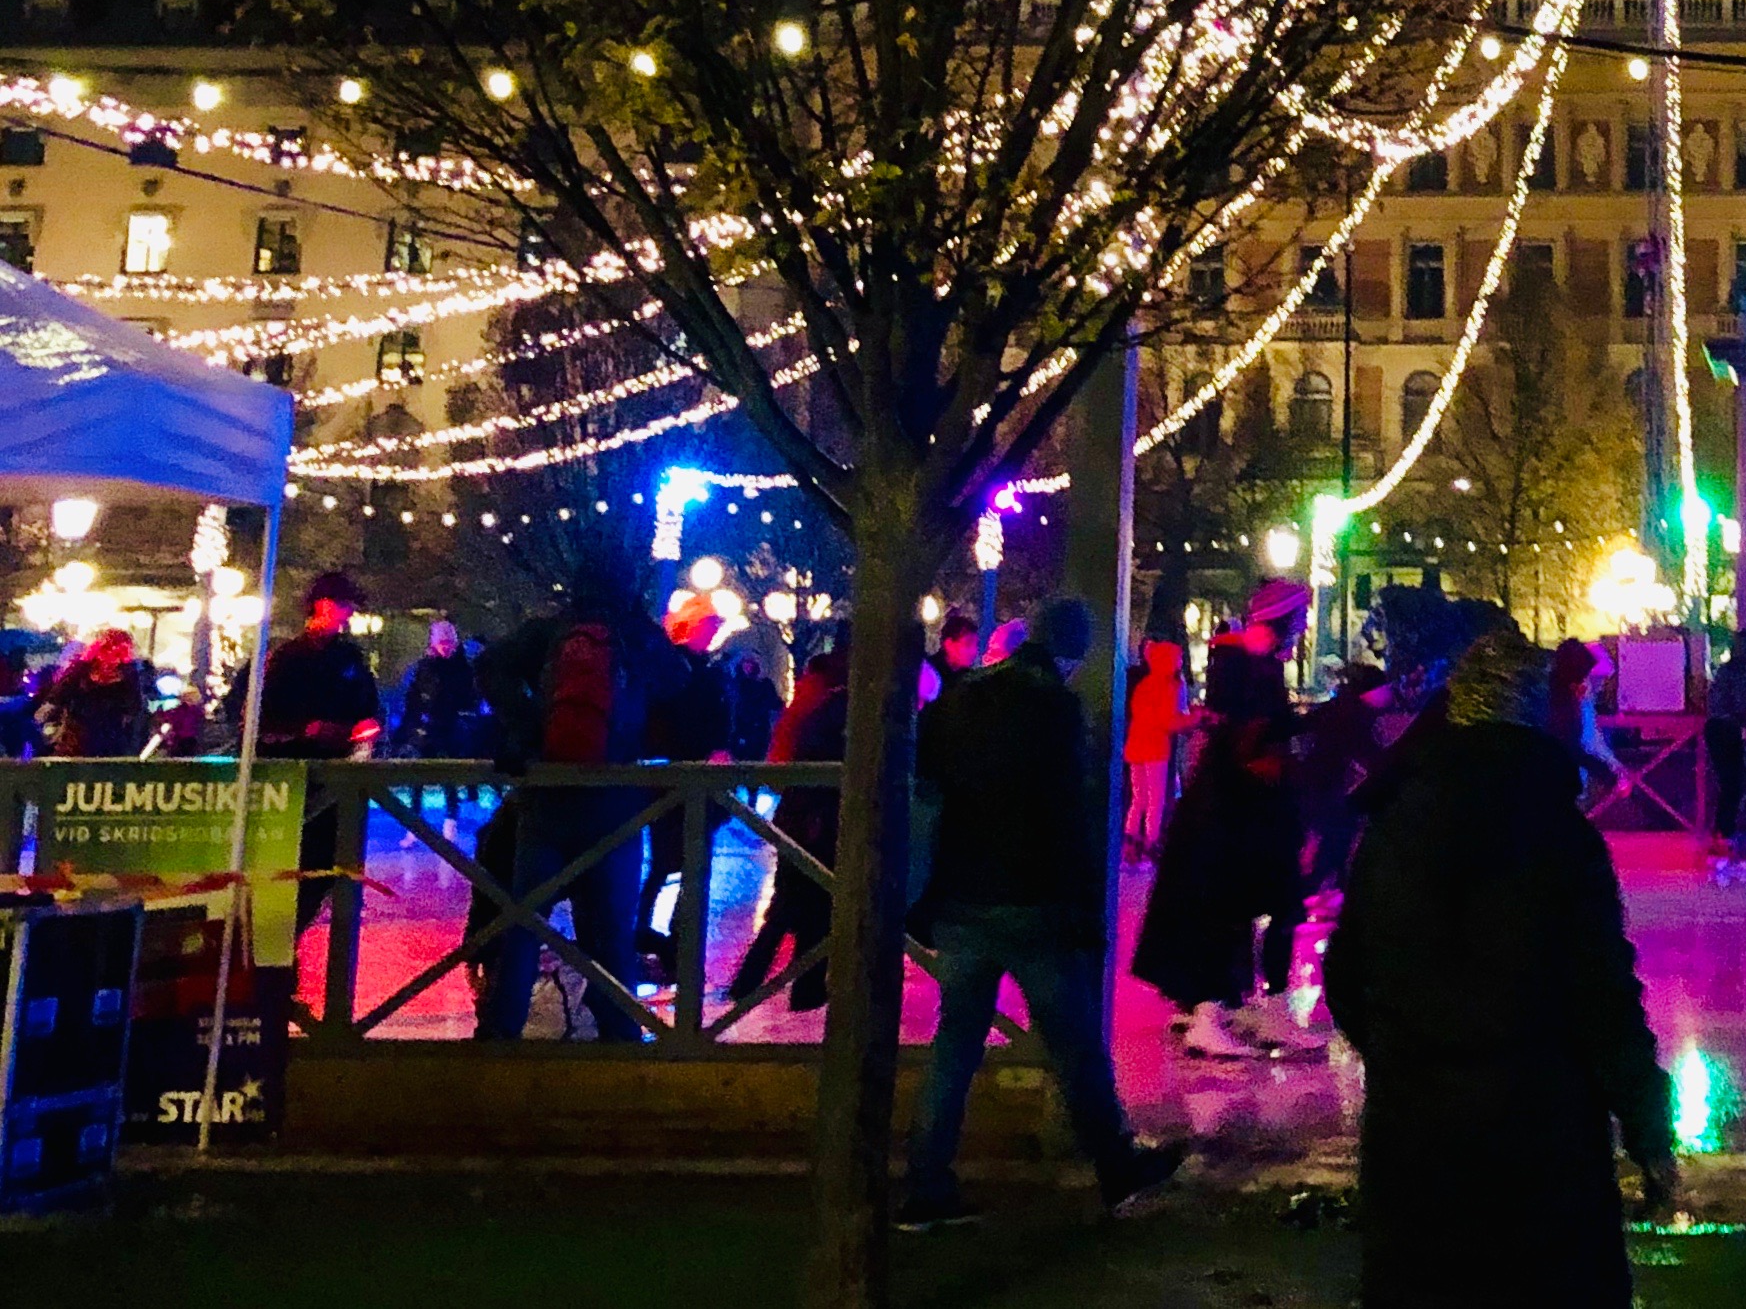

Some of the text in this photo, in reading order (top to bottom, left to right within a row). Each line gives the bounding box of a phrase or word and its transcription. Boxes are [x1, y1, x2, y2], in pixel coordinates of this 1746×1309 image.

[56, 782, 288, 812] JULMUSIKEN
[55, 826, 90, 842] VID
[157, 1091, 244, 1123] STAR
